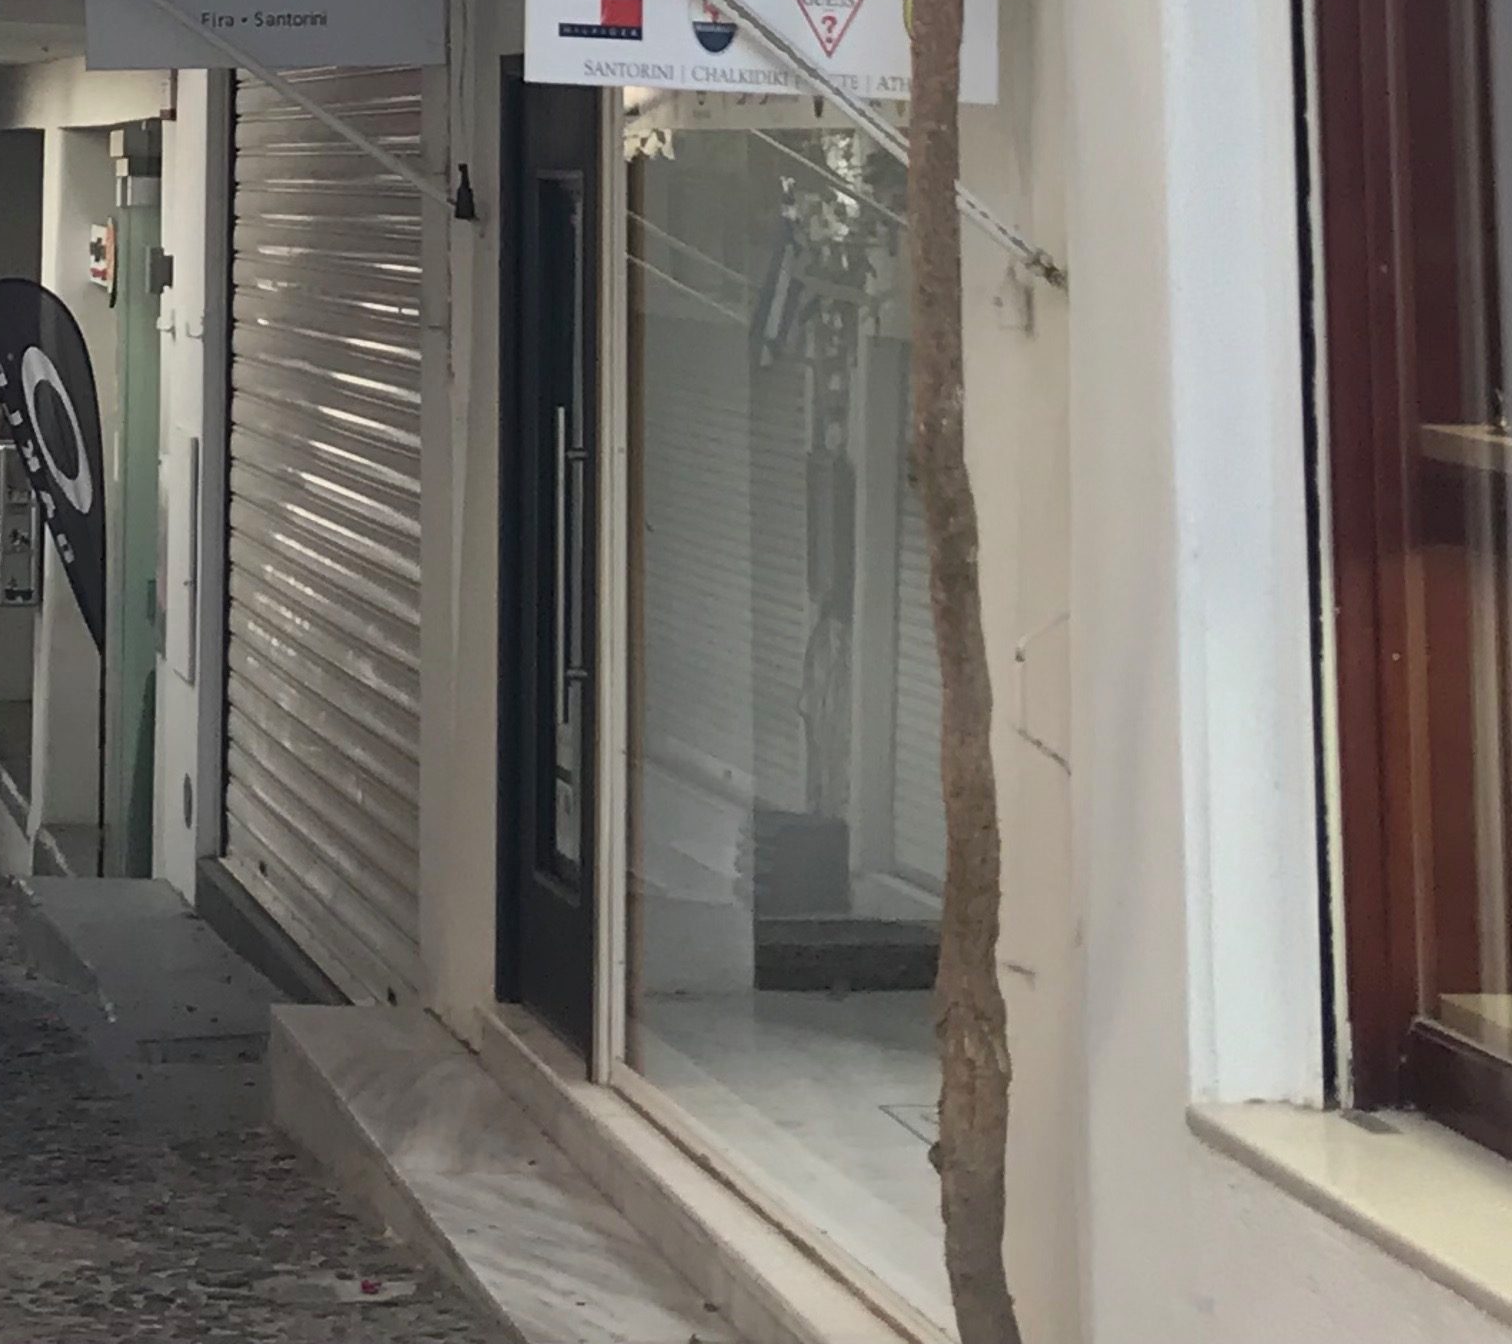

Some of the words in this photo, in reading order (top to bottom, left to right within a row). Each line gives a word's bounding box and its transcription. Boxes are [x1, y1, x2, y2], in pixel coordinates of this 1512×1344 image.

[201, 11, 235, 28] Fira
[254, 11, 328, 28] Santorini
[584, 60, 675, 81] SANTORINI
